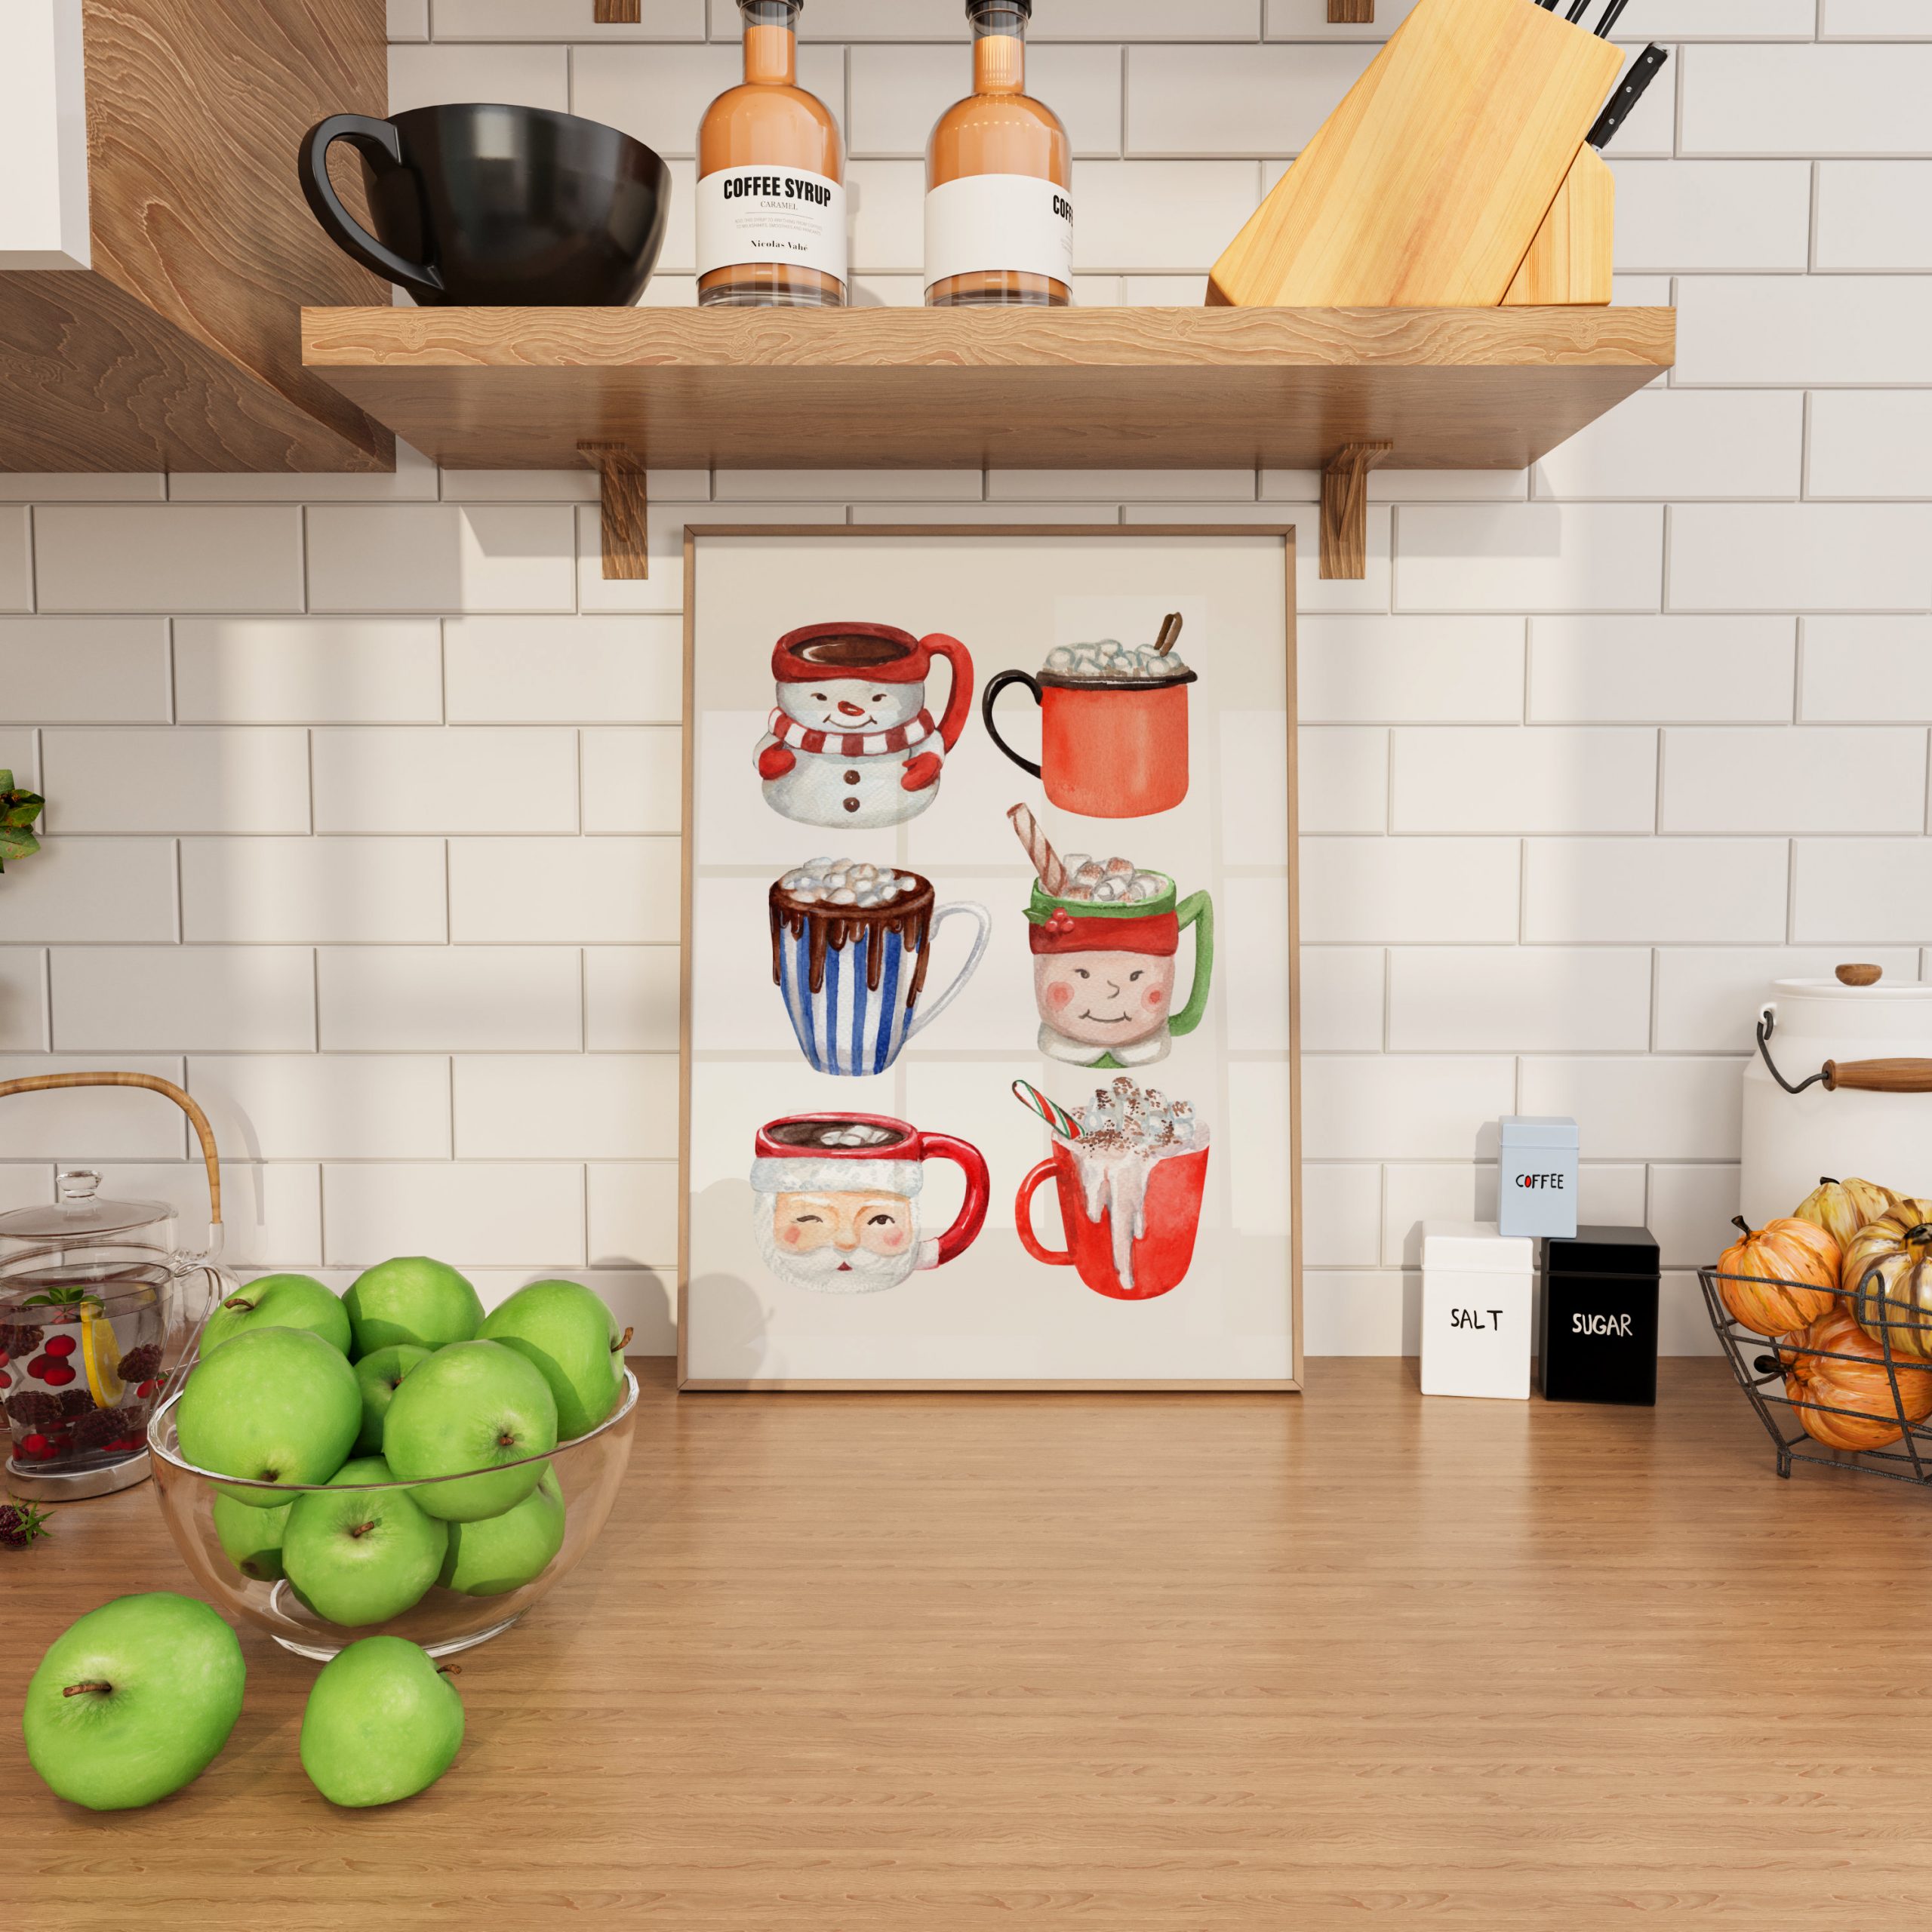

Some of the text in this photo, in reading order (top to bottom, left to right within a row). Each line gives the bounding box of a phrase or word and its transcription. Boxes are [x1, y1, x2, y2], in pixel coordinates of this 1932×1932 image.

[724, 177, 831, 207] COFFEE SYRUP
[760, 201, 798, 210] CARAMEL
[1515, 1173, 1564, 1189] COFFEE
[1451, 1308, 1503, 1331] SALT
[1572, 1313, 1633, 1337] SUGAR
